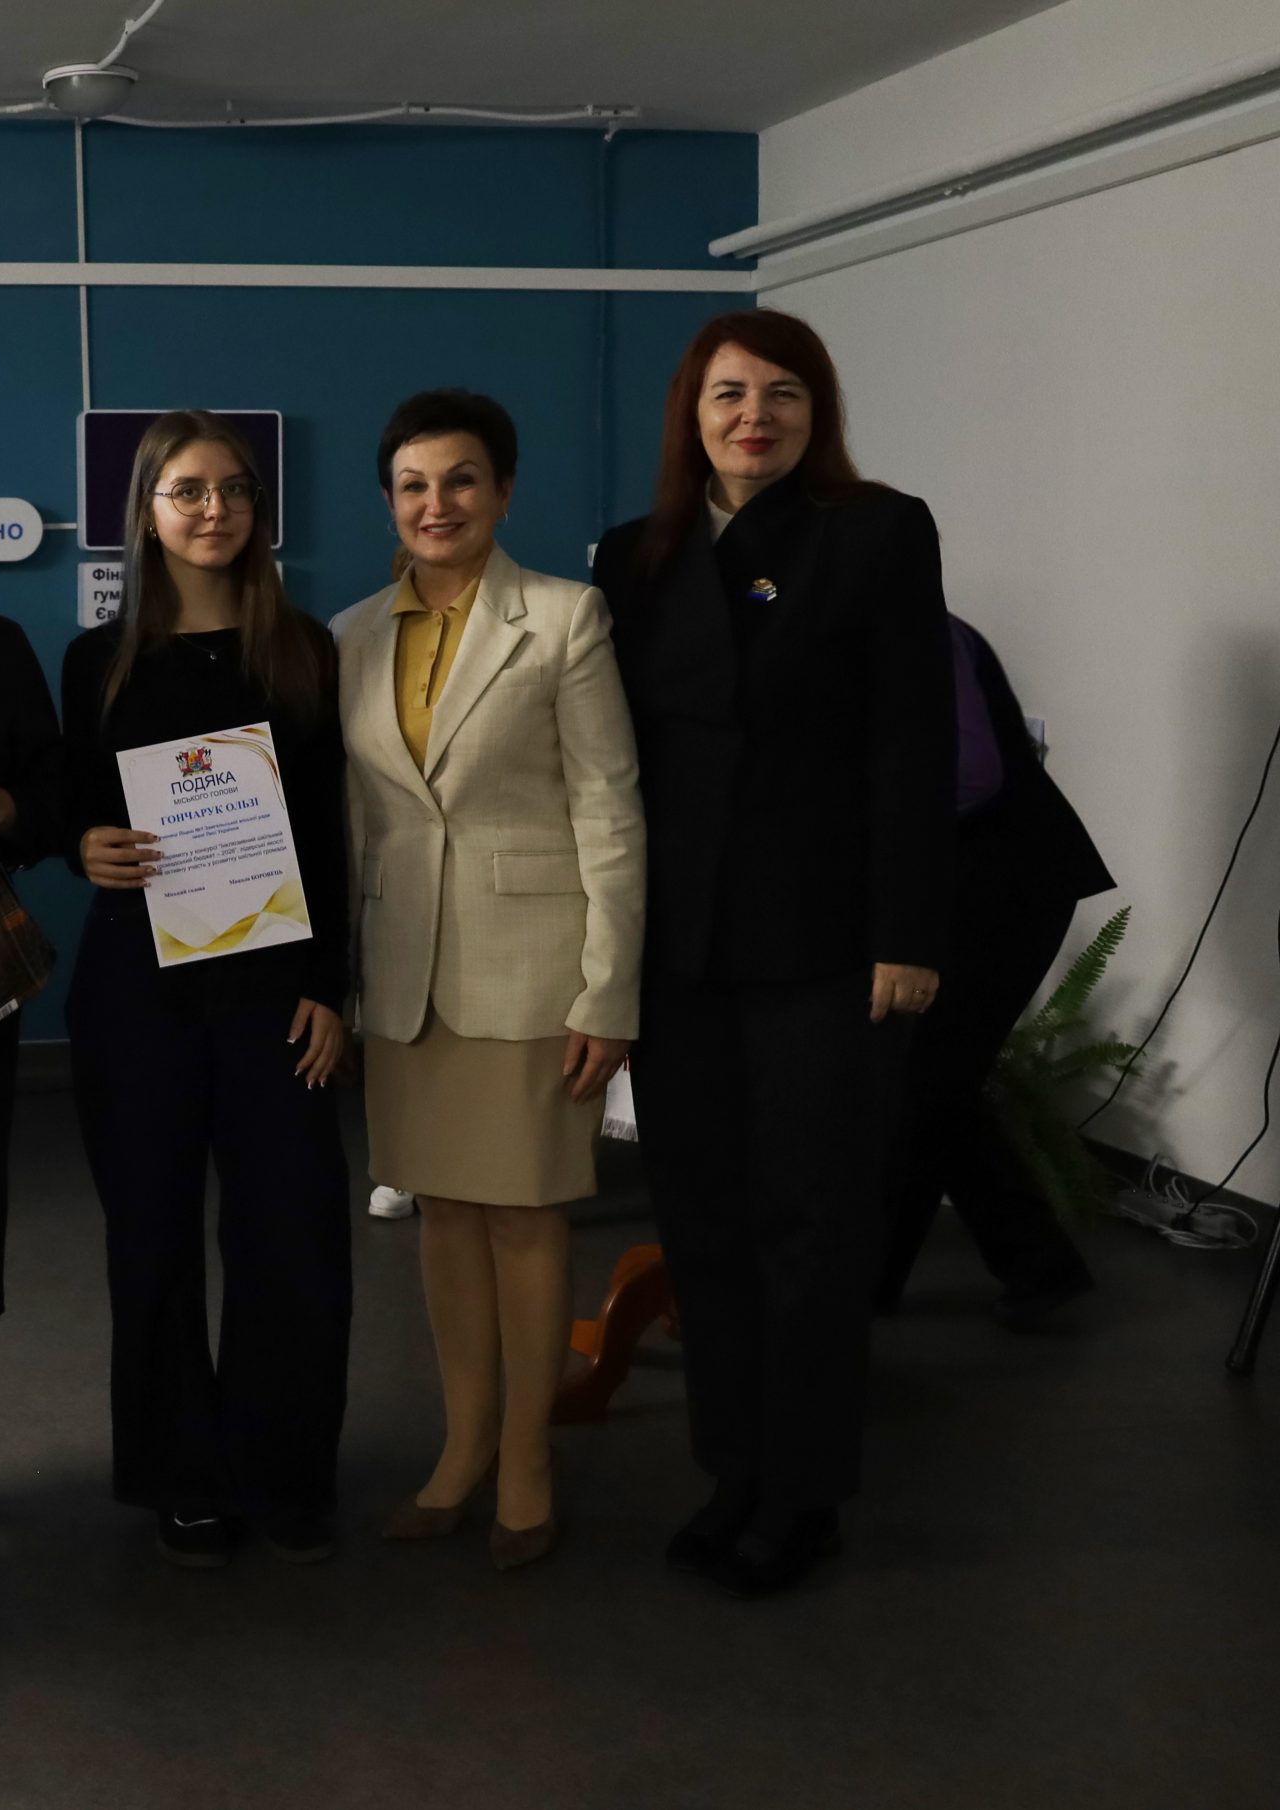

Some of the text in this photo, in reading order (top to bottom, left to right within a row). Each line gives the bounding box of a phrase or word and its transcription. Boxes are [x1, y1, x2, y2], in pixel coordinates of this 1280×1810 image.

[92, 568, 122, 581] Фін
[93, 590, 122, 604] гум
[95, 606, 117, 621] Єв
[170, 771, 236, 795] ПОДЯКА
[173, 786, 238, 805] МІСЬКОГО ГОЛОВИ
[161, 797, 258, 826] ГОНЧАРУК ОЛЬЗІ
